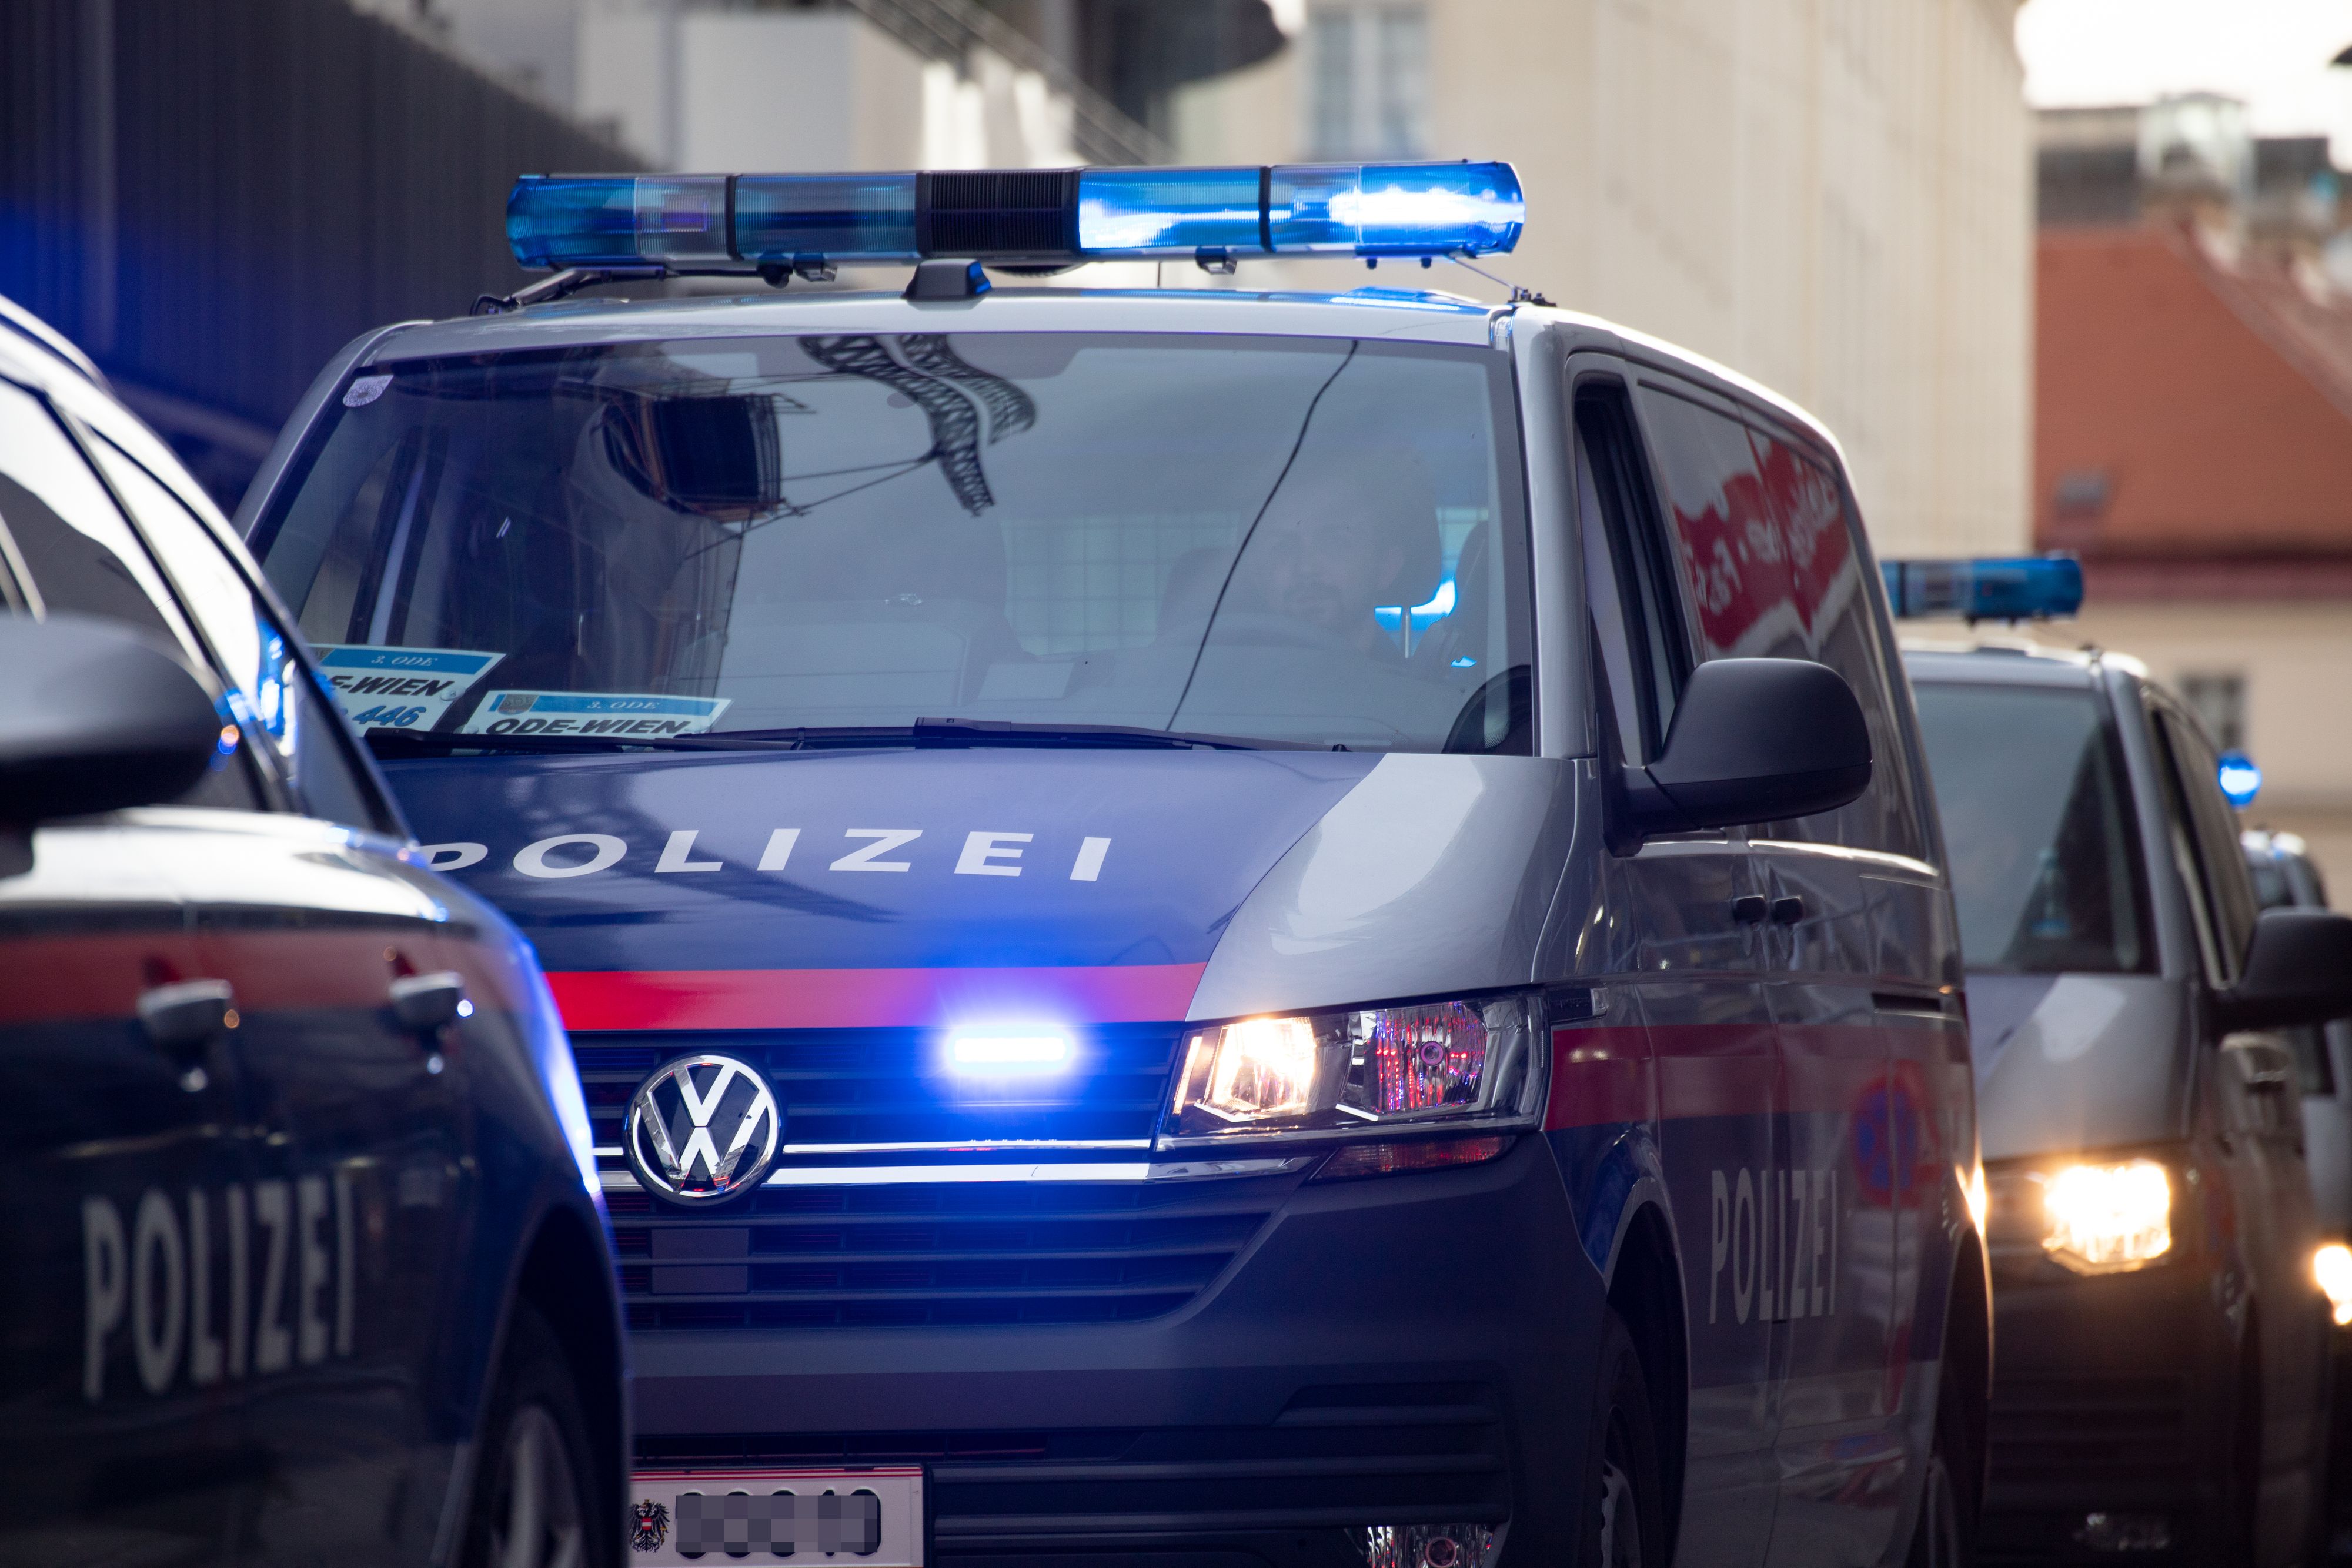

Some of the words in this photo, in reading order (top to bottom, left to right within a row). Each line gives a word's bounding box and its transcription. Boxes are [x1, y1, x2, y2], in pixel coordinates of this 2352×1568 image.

[370, 654, 384, 664] 3.
[390, 656, 439, 667] ODE
[587, 700, 602, 710] 3.
[610, 701, 660, 710] ODE
[486, 718, 691, 734] ODE-WIEN
[413, 828, 1111, 882] POLIZEI
[1709, 1167, 1838, 1325] POLIZEI
[81, 1170, 354, 1403] POLIZEI
